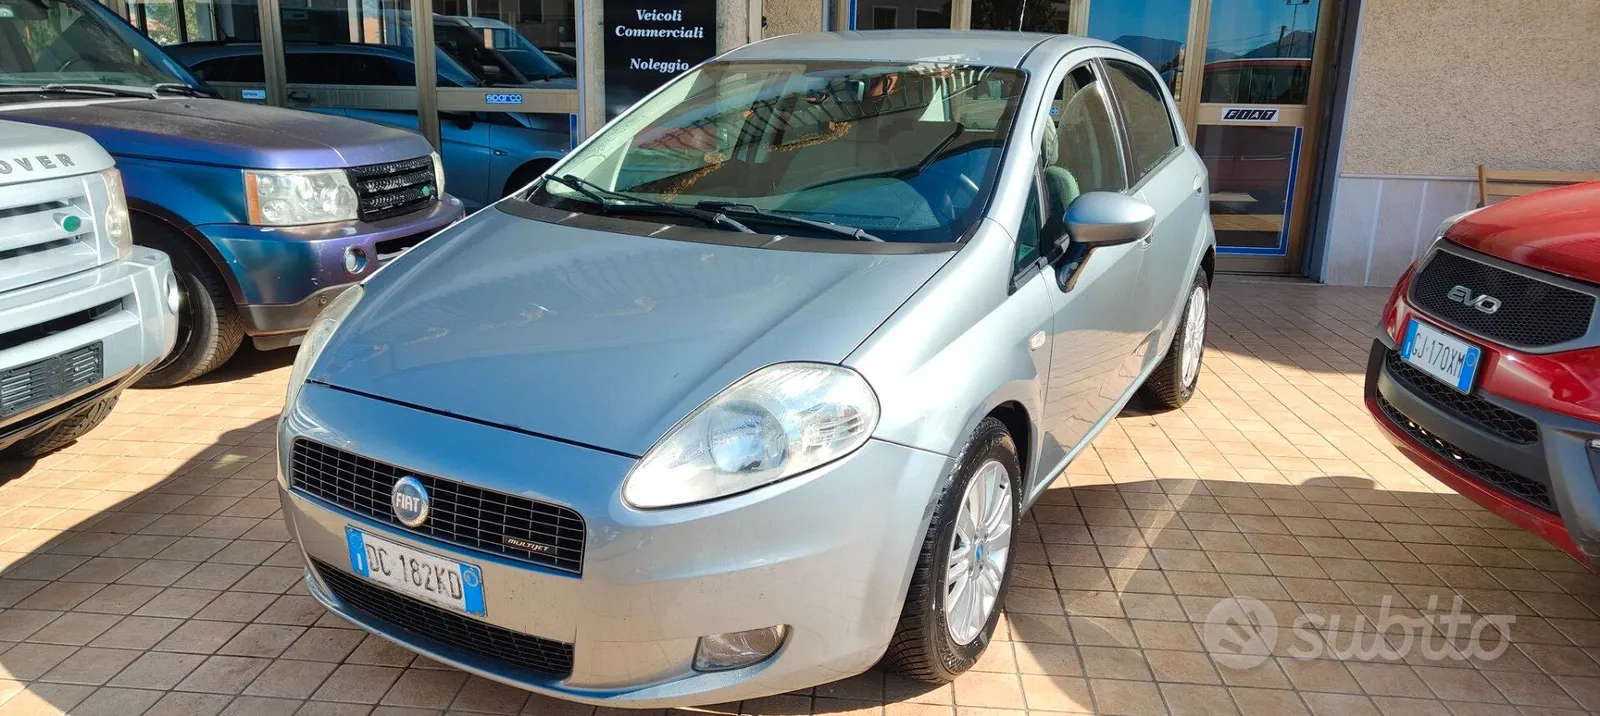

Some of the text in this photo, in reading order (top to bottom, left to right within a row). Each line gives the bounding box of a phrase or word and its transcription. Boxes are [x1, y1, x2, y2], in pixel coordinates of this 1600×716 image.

[636, 9, 682, 21] Veicoli
[615, 25, 704, 39] Commerciali
[629, 58, 689, 73] Noleggio
[1226, 109, 1274, 119] FIAT
[1447, 285, 1502, 314] EVO
[396, 492, 420, 513] FIAT
[507, 538, 550, 551] MULTIJET
